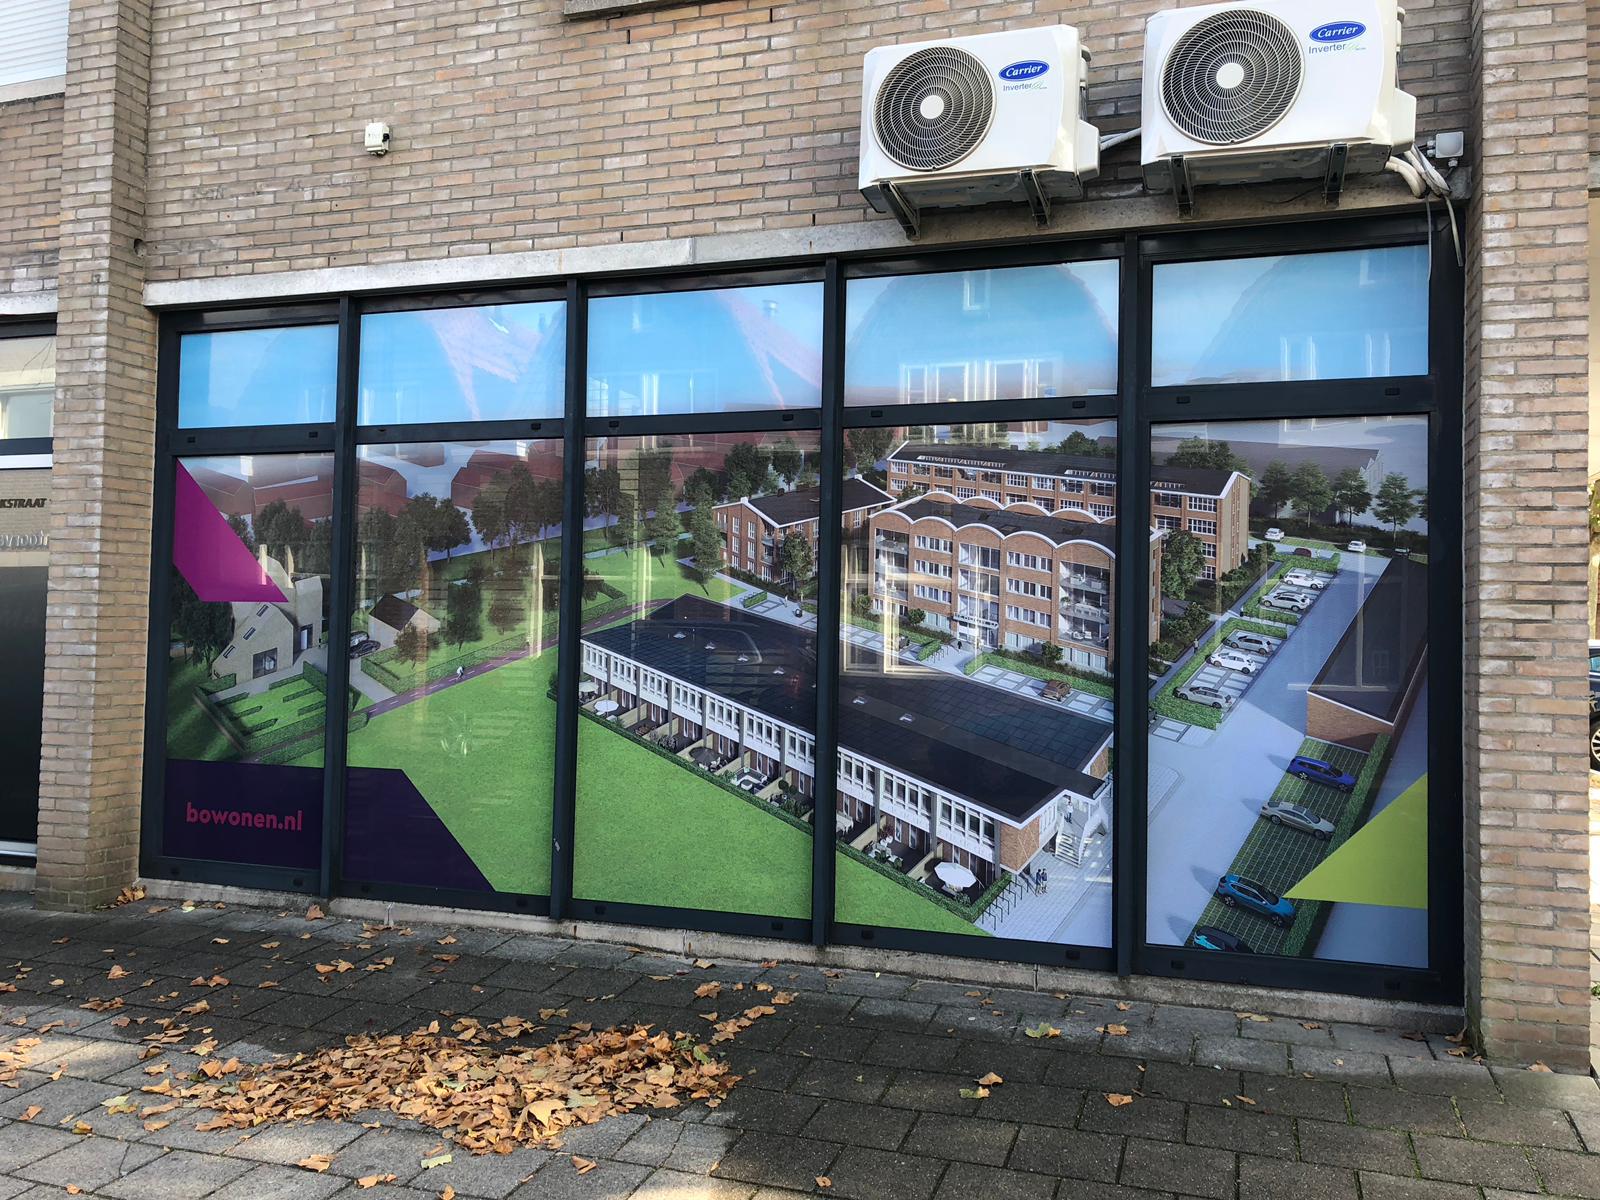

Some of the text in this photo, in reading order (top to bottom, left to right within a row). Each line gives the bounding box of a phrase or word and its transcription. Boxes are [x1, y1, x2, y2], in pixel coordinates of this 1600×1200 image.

[1317, 26, 1358, 38] Carrier
[1309, 43, 1346, 54] Inverter
[1005, 64, 1043, 77] Carrier
[186, 801, 303, 831] bowonen.nl
